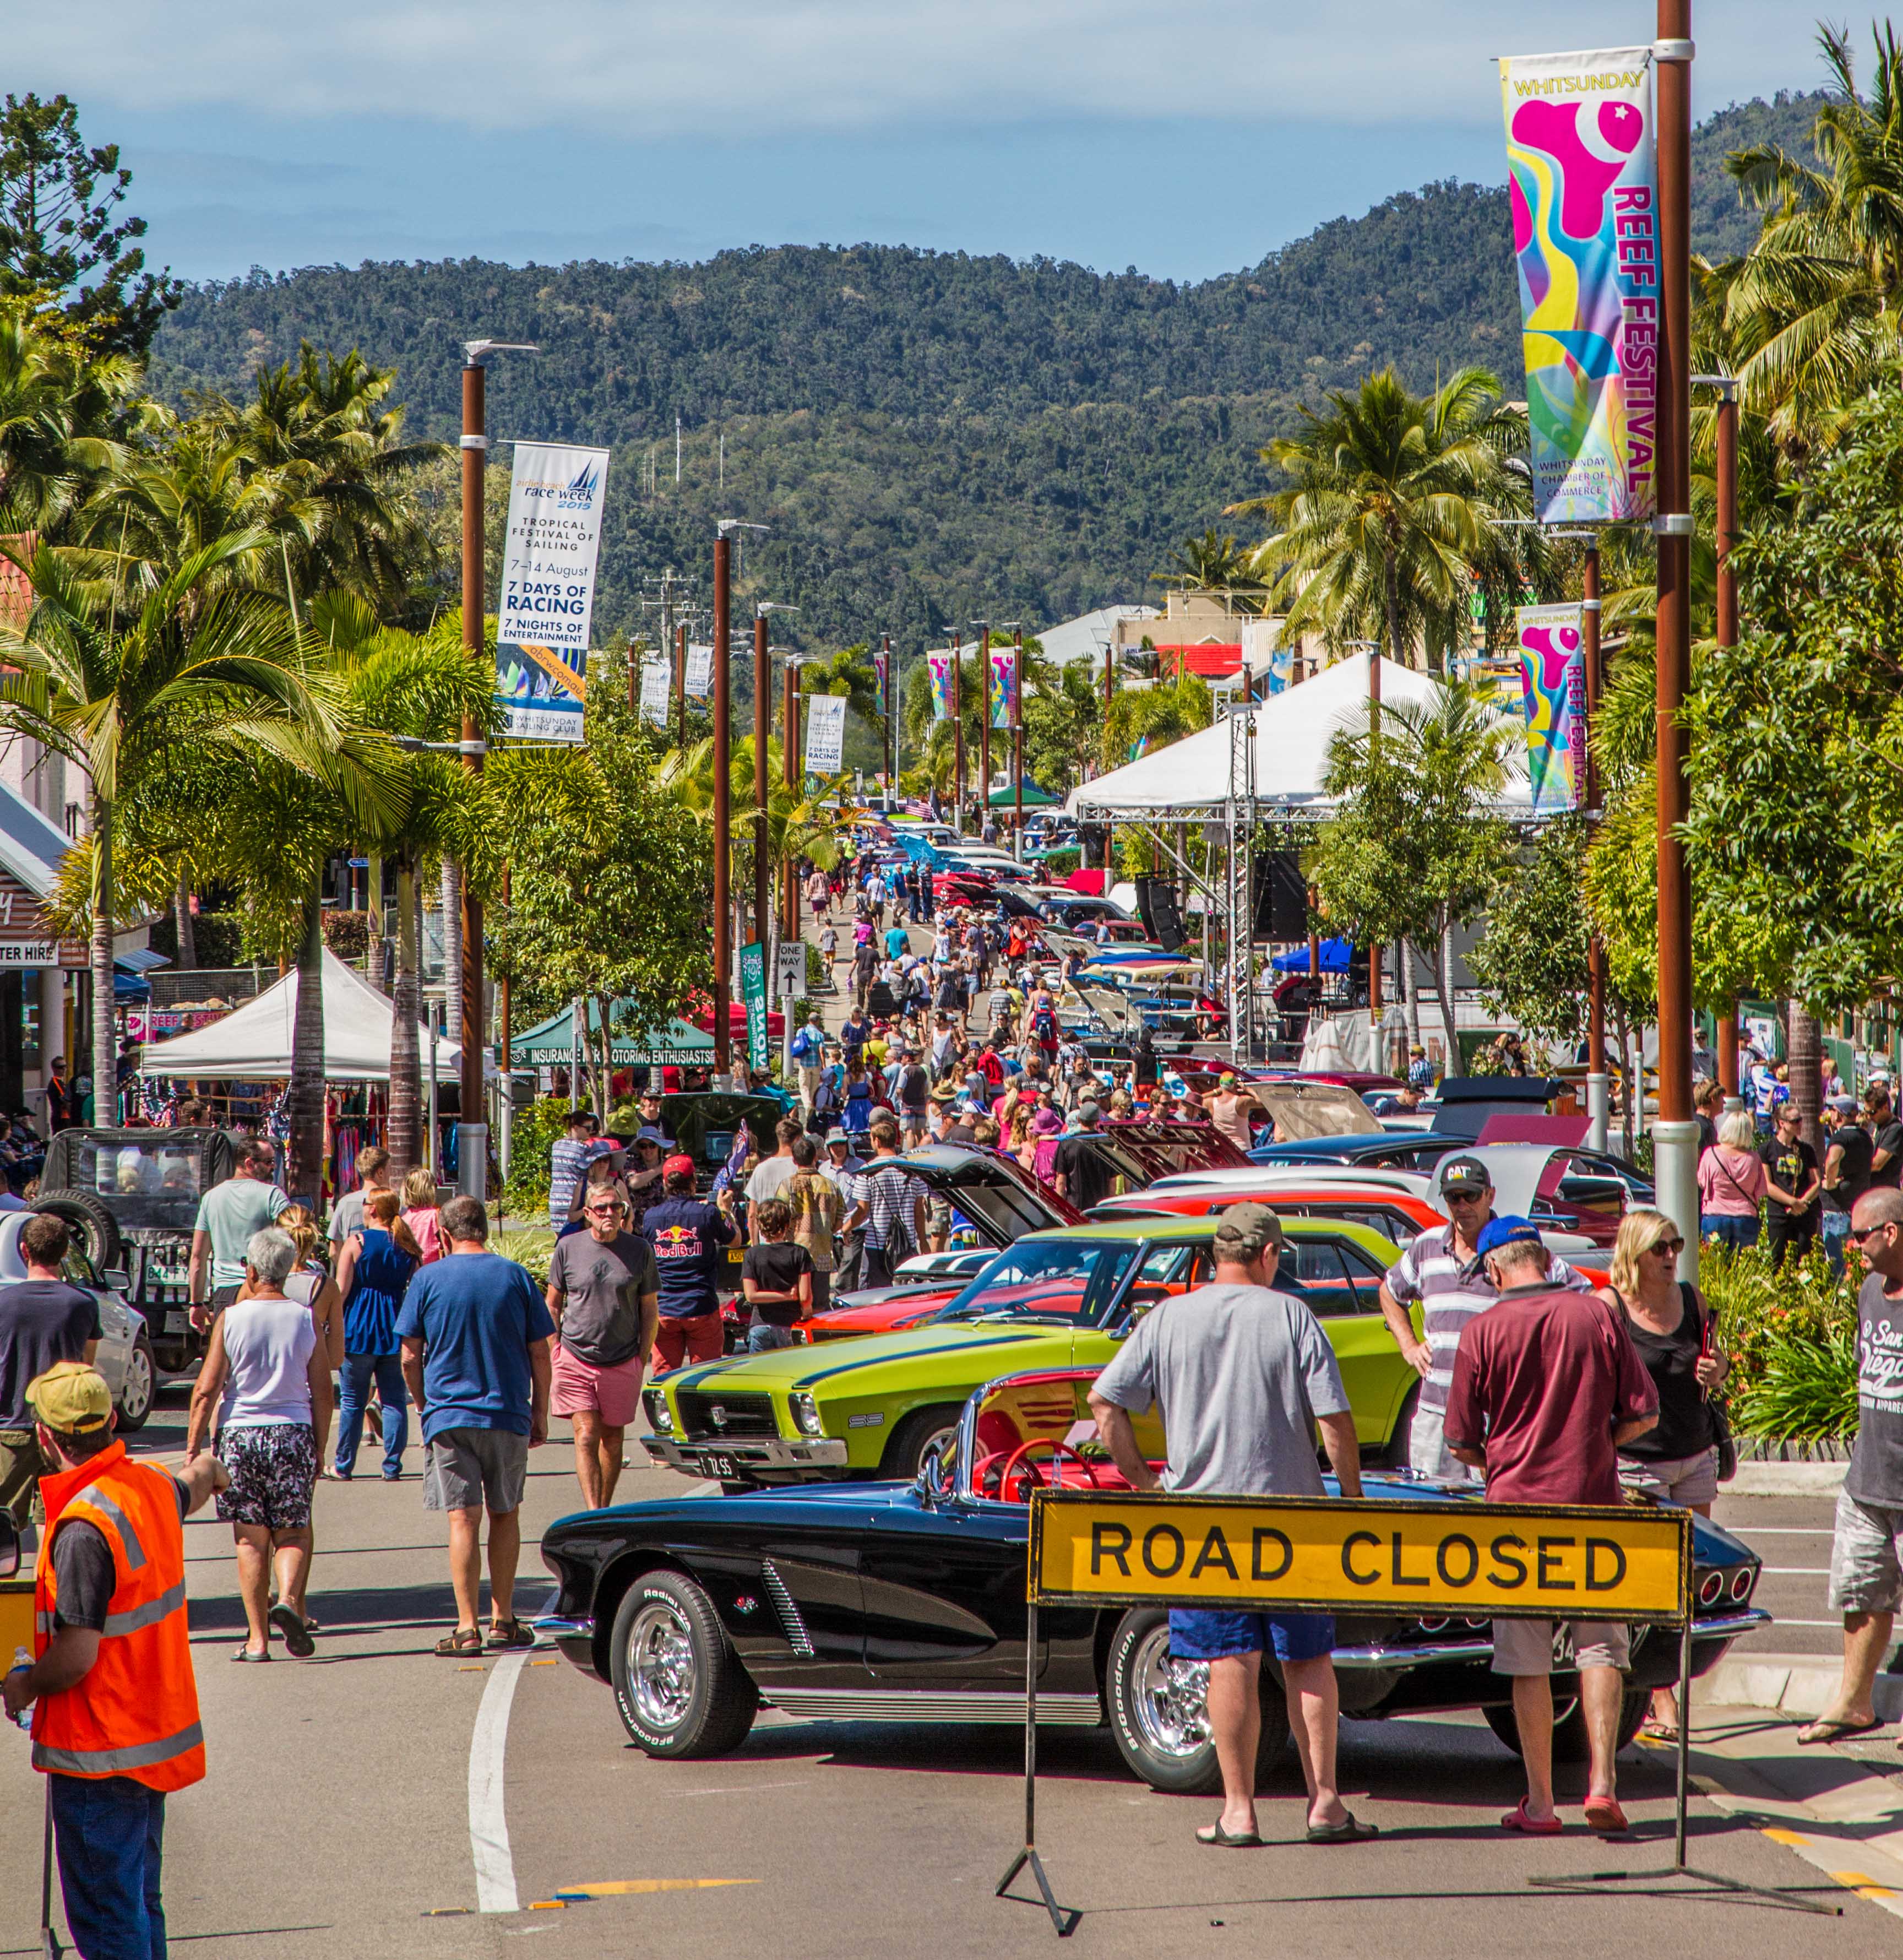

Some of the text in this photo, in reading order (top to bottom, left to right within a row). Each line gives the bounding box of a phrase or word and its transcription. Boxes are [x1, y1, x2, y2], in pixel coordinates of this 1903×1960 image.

[1514, 70, 1644, 96] WHITSUNDAY
[1613, 185, 1657, 493] REEF FESTIVAL
[1540, 457, 1606, 472] WHITSUNDAY
[1541, 472, 1606, 486] CHAMBER OF
[525, 486, 594, 502] race week
[1547, 486, 1602, 498] COMMERCE
[557, 501, 592, 511] 2015
[523, 518, 585, 530] TROPICAL
[512, 528, 594, 541] FESTIVAL OF
[525, 540, 578, 551] SAILING
[545, 563, 588, 578] August
[508, 581, 587, 598] 7 DAYS OF
[507, 595, 585, 615] RACING
[504, 618, 583, 633] 7 NIGHTS OF
[1521, 613, 1579, 625] WHITSUNDAY
[503, 629, 583, 643] ENTERTAINMENT
[516, 715, 577, 725] WHITSUNDAY
[516, 723, 576, 732] SAILING CLUB
[1567, 665, 1585, 802] REEF FESTIVAL
[808, 752, 839, 761] RACING
[25, 947, 53, 960] HIRE
[781, 946, 801, 955] ONE
[780, 957, 801, 966] WAY
[151, 1015, 180, 1027] REEF
[611, 1049, 651, 1064] OTORING
[652, 1050, 711, 1065] ENTHUSIASTS
[1448, 1165, 1468, 1181] CAT
[654, 1242, 702, 1258] Red Bull
[148, 1267, 168, 1279] 844
[849, 1413, 884, 1428] SS
[1091, 1521, 1626, 1590] ROAD CLOSED
[643, 1588, 678, 1609] Radial
[1114, 1630, 1139, 1752] BFGoodrich
[618, 1690, 675, 1746] BFGoodrich
